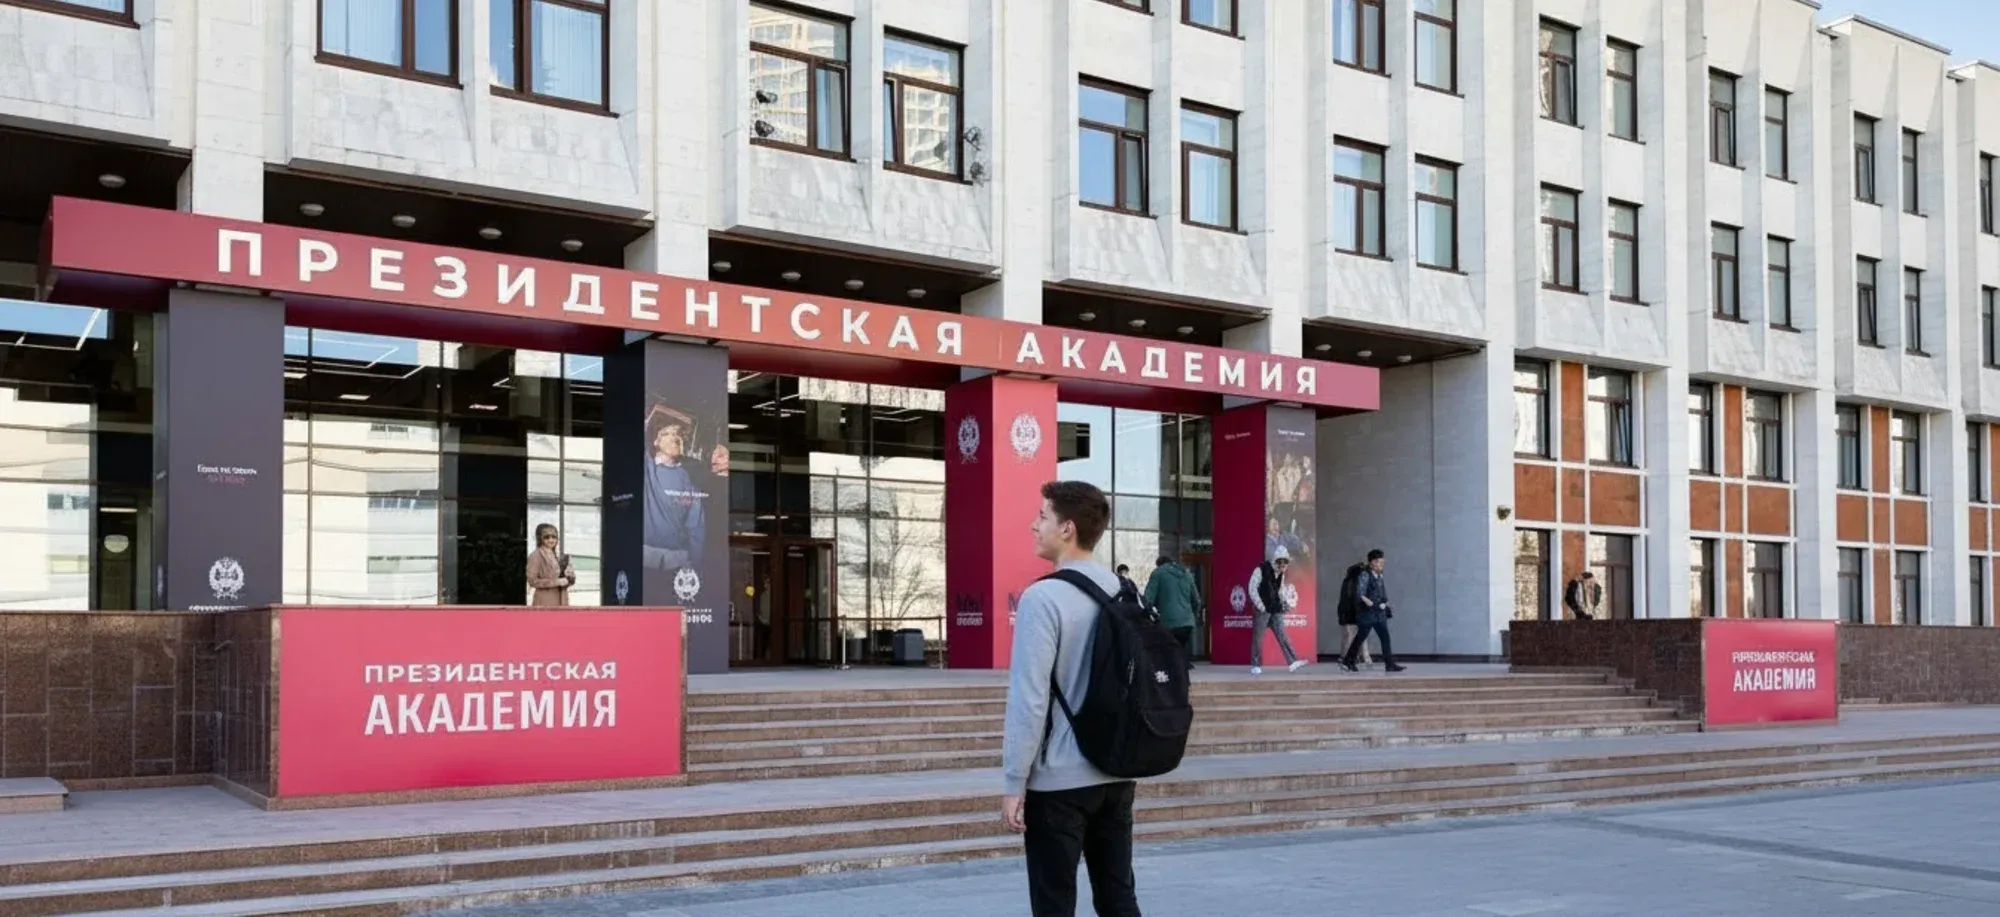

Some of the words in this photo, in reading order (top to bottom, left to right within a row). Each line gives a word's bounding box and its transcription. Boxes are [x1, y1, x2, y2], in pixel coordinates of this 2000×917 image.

[218, 229, 962, 354] ПРЕЗИДЕНТСКАЯ
[1017, 333, 1316, 395] АКАДЕМИЯ
[364, 662, 616, 683] ПРЕЗИДЕНТСКАЯ
[1733, 667, 1816, 692] АКАДЕМИЯ
[364, 690, 616, 735] АКАДЕМИЯ
